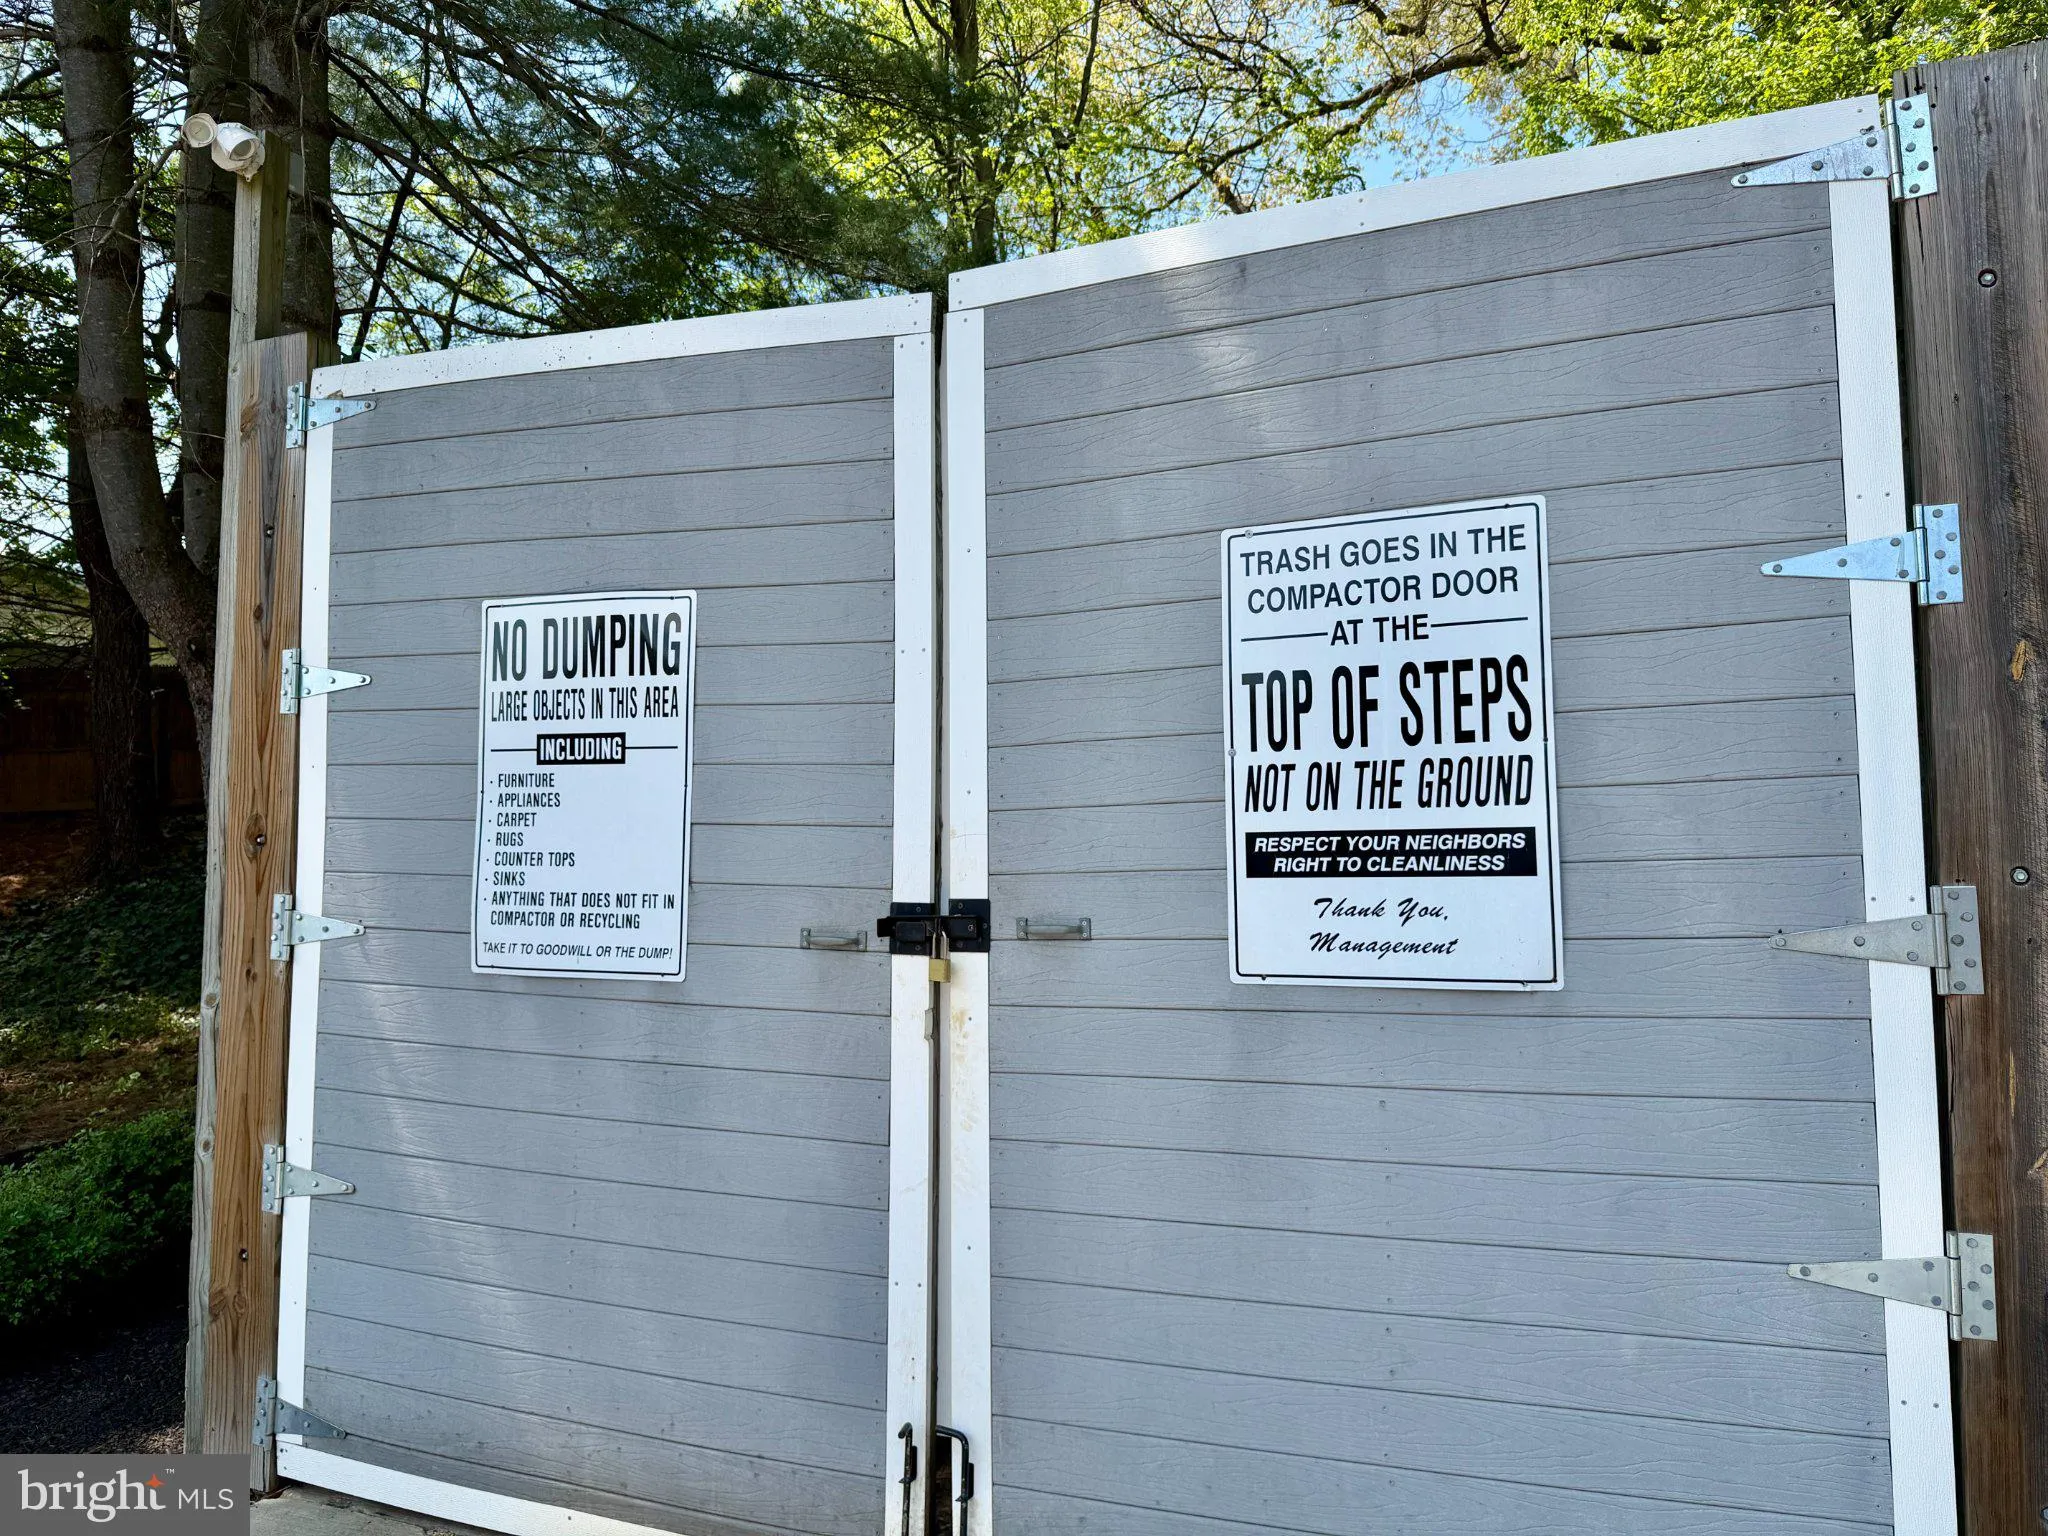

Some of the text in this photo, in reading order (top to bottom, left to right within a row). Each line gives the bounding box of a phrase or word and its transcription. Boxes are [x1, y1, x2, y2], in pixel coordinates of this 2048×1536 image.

[1240, 524, 1526, 576] TRASH GOES IN THE
[1247, 566, 1518, 614] COMPACTOR DOOR
[1331, 614, 1429, 646] AT THE
[492, 613, 681, 681] NO DUMPING
[492, 686, 678, 722] LARGE OBJECTS IN THIS AREA
[1242, 654, 1531, 752] TOP OF STEPS
[540, 737, 622, 760] INCLUDING
[499, 773, 554, 787] FURNITURE
[1245, 755, 1533, 812] NOT ON THE GROUND
[498, 793, 560, 807] APPLIANCES
[497, 813, 537, 826] CARPET
[496, 832, 523, 846] RUGS
[1255, 833, 1525, 852] RESPECT YOUR NEIGHBORS
[495, 852, 575, 867] COUNTER TOPS
[1274, 855, 1505, 872] RIGHT TO CLEANLINESS
[493, 871, 525, 886] SINKS
[492, 891, 674, 909] ANYTHING THAT DOES NOT FIT IN
[491, 911, 639, 929] COMPACTOR OR RECYCLING
[1313, 897, 1449, 927] Thank You,
[483, 942, 672, 959] TAKE IT TO GOODWILL OR THE DUMP!
[1309, 932, 1459, 959] Management
